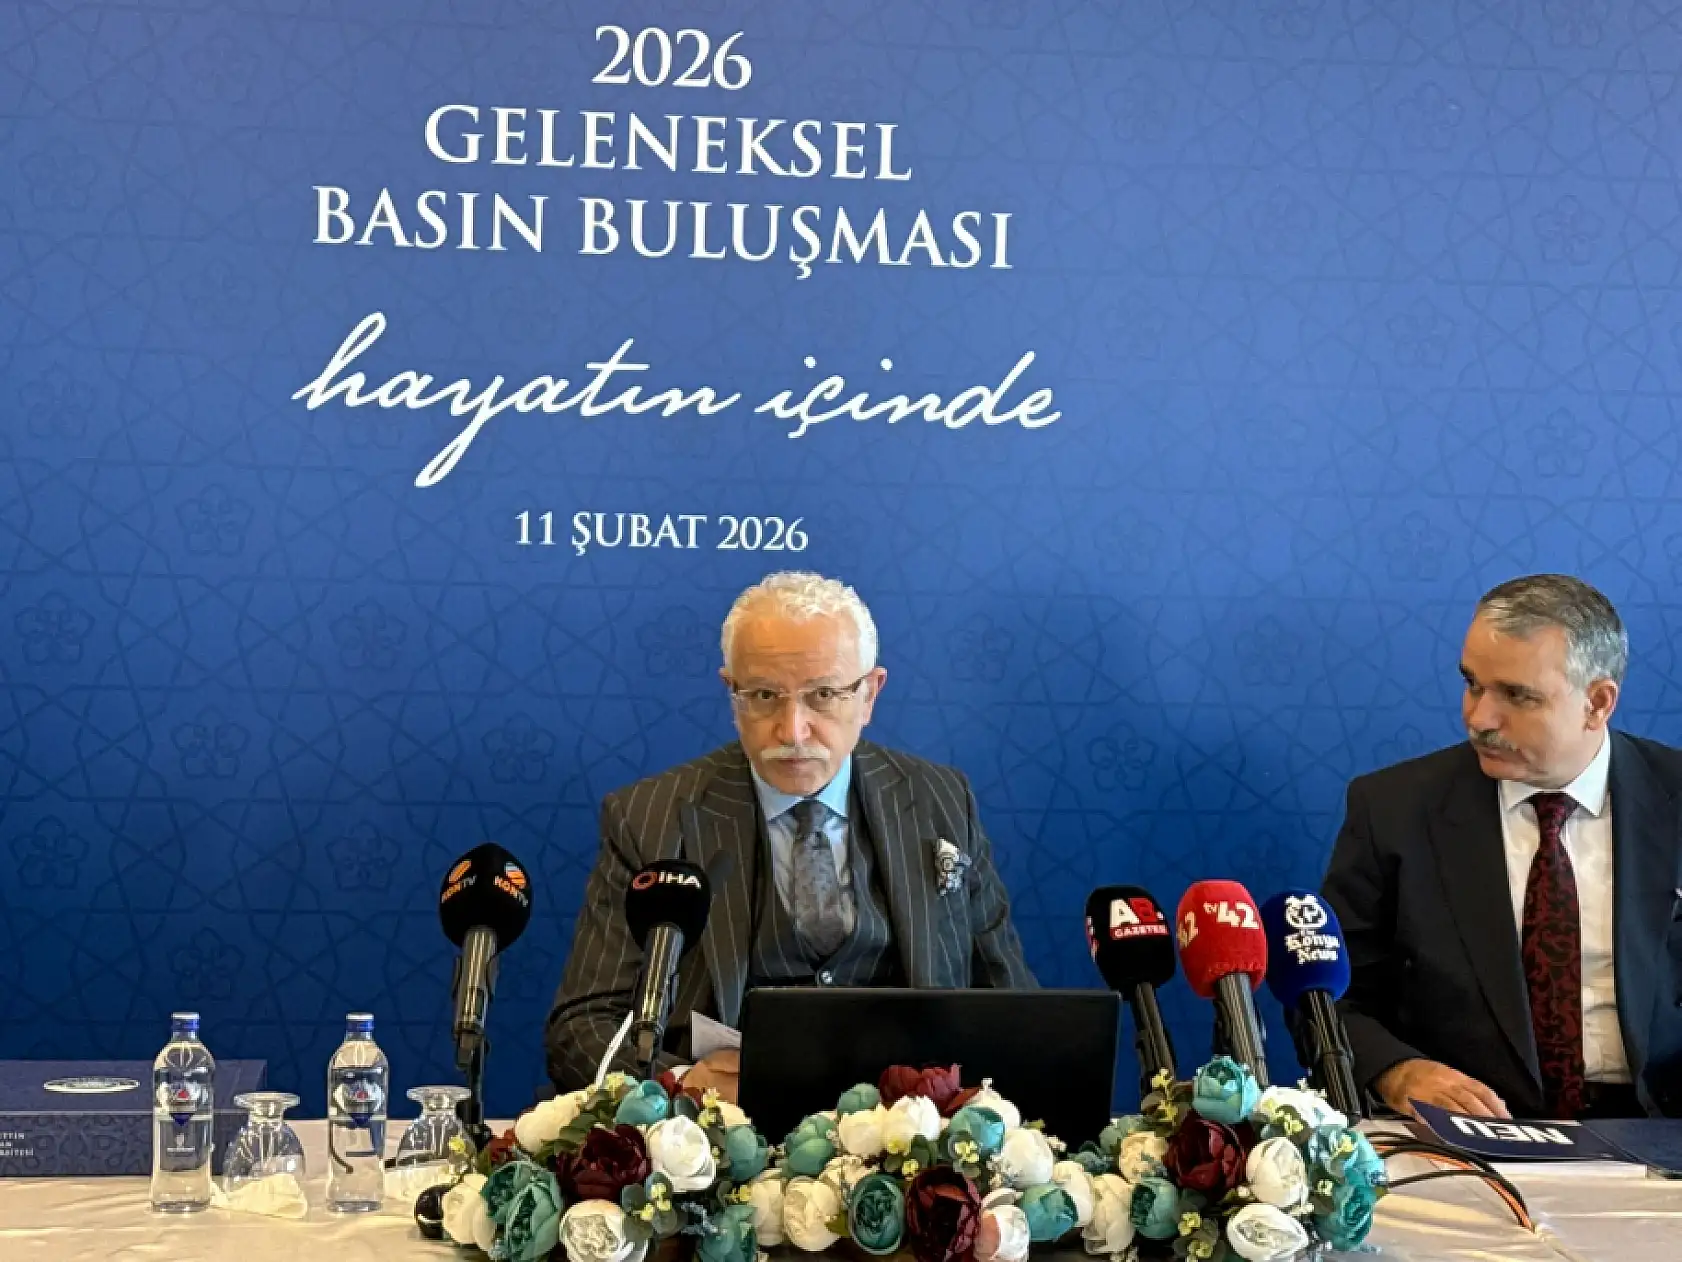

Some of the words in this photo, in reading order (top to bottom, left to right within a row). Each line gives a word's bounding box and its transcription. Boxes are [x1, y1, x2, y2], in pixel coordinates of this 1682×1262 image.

[591, 25, 752, 91] 2026
[424, 104, 912, 181] GELENEKSEL
[312, 185, 549, 253] BASIN
[578, 198, 1013, 280] BULUŞMASI
[291, 312, 741, 488] hayatın
[754, 350, 1061, 439] içinde
[516, 510, 554, 545] 11
[571, 511, 708, 556] ŞUBAT
[717, 516, 809, 551] 2026
